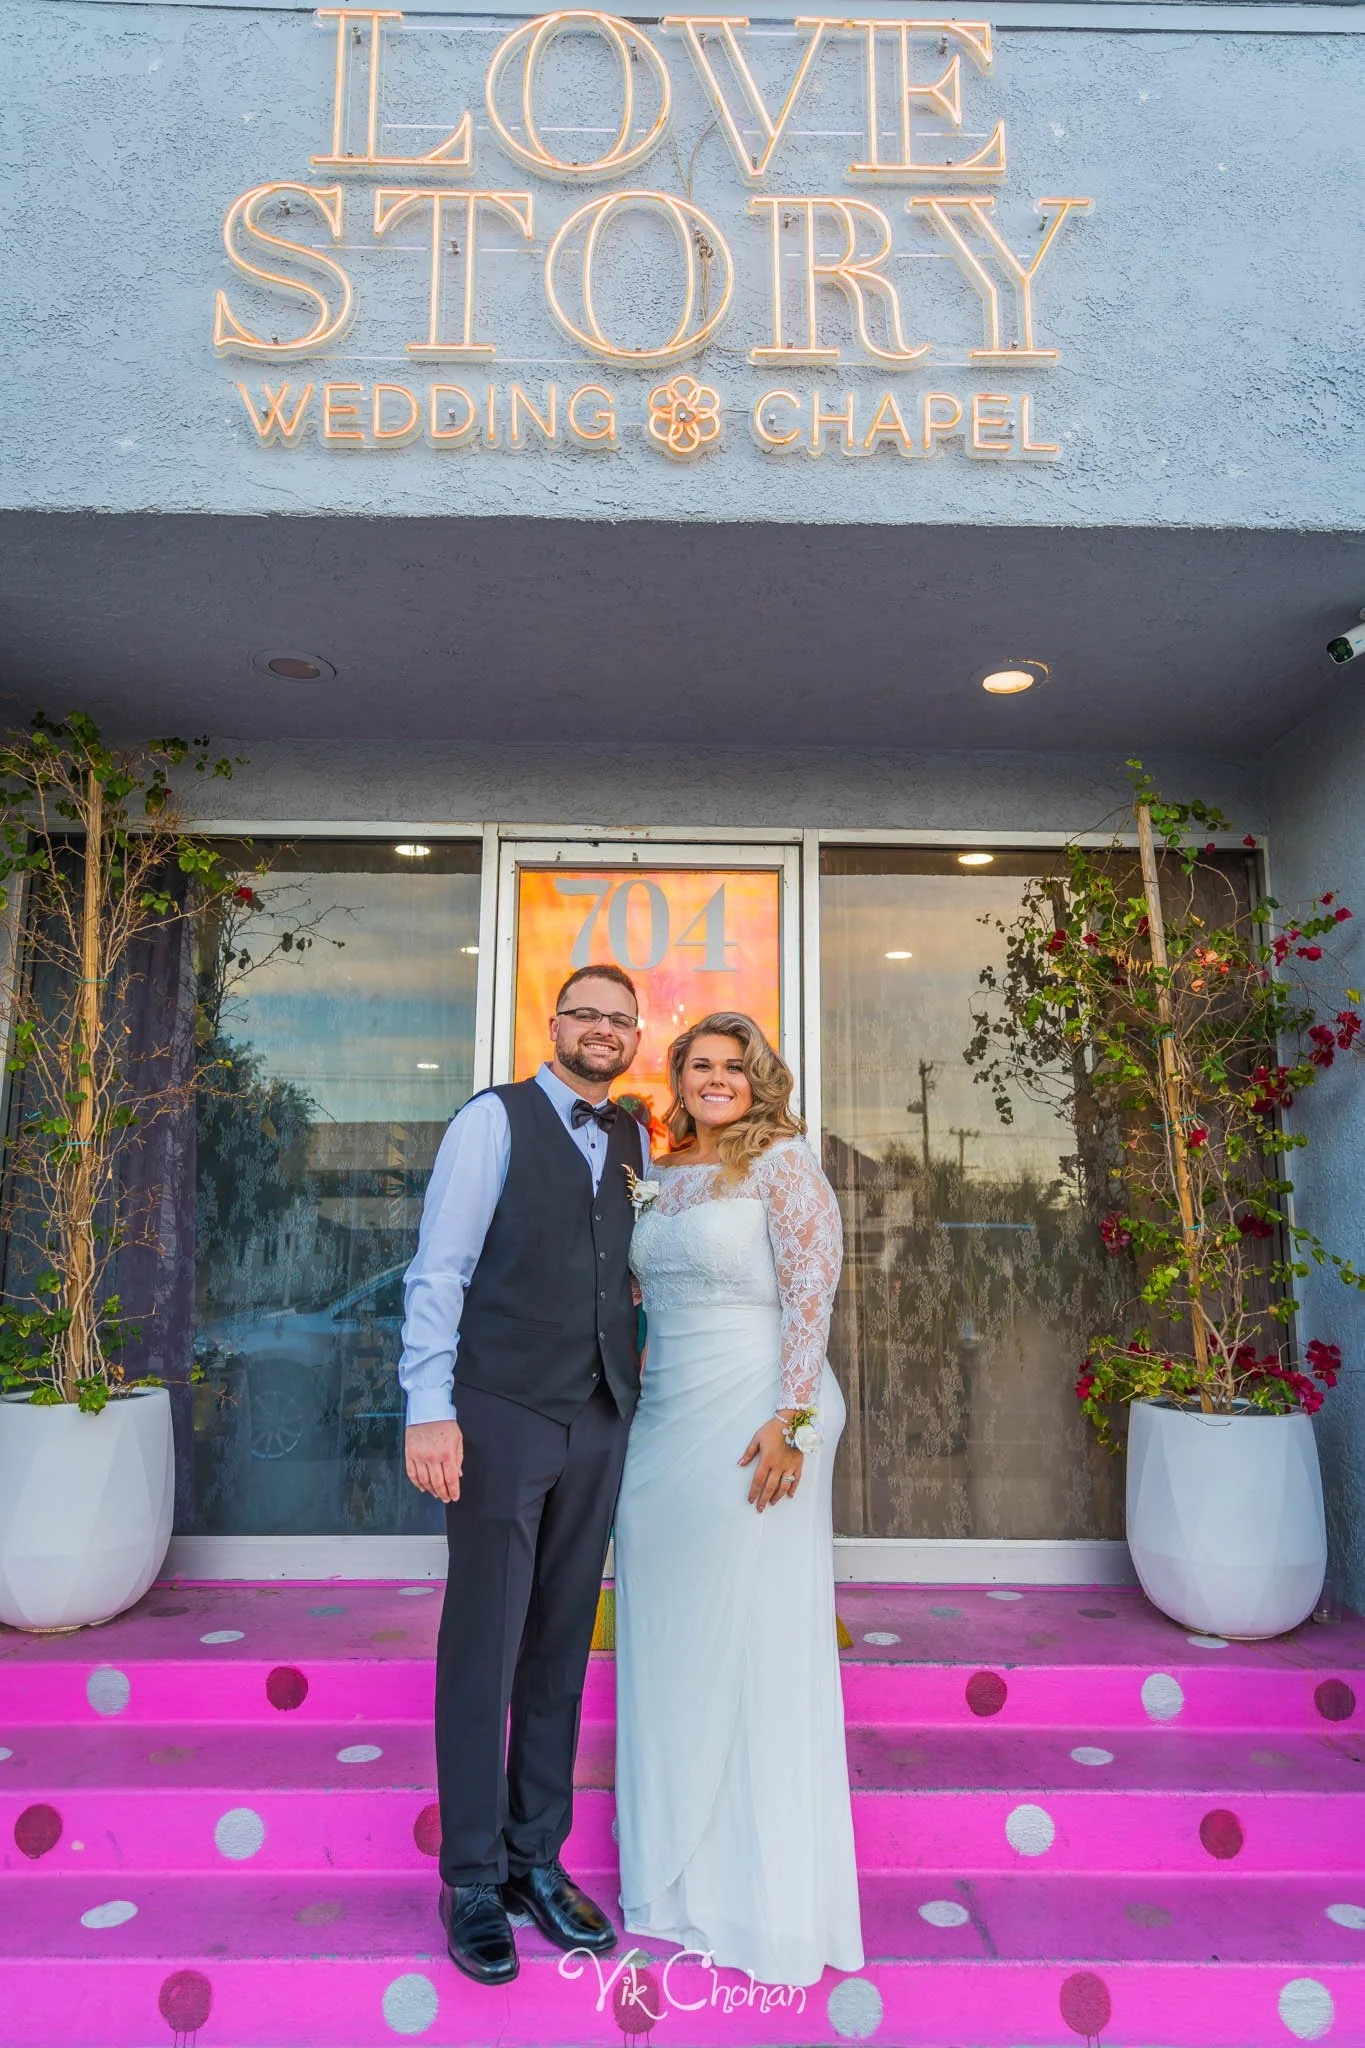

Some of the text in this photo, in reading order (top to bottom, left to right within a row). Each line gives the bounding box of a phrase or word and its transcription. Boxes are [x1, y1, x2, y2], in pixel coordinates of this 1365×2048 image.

[310, 9, 1007, 177] LOVE
[212, 181, 1091, 361] STORY
[237, 381, 1062, 462] WEDDING CHAPEL
[554, 877, 740, 973] 704
